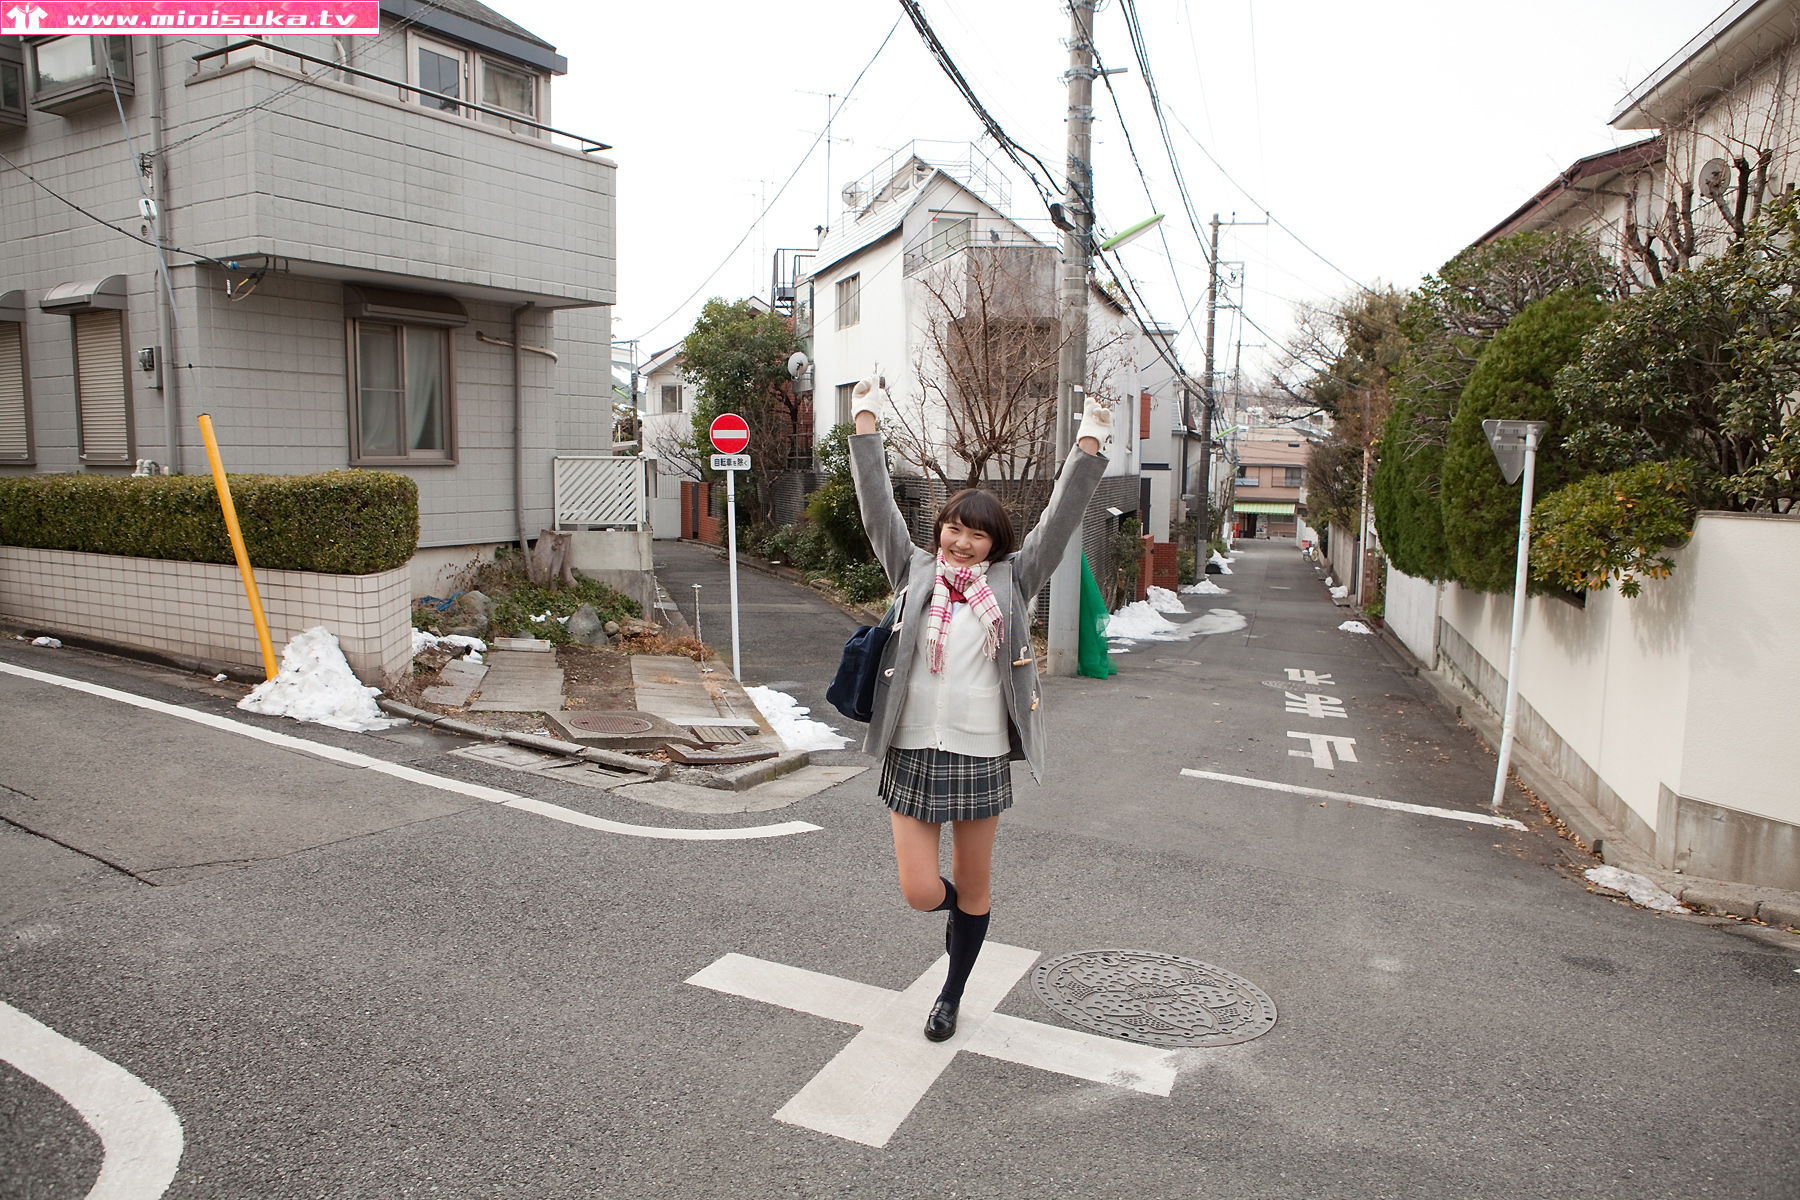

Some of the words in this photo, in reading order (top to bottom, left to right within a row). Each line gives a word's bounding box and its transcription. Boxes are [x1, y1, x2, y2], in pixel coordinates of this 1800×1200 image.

[714, 457, 748, 467] 自転車を除く
